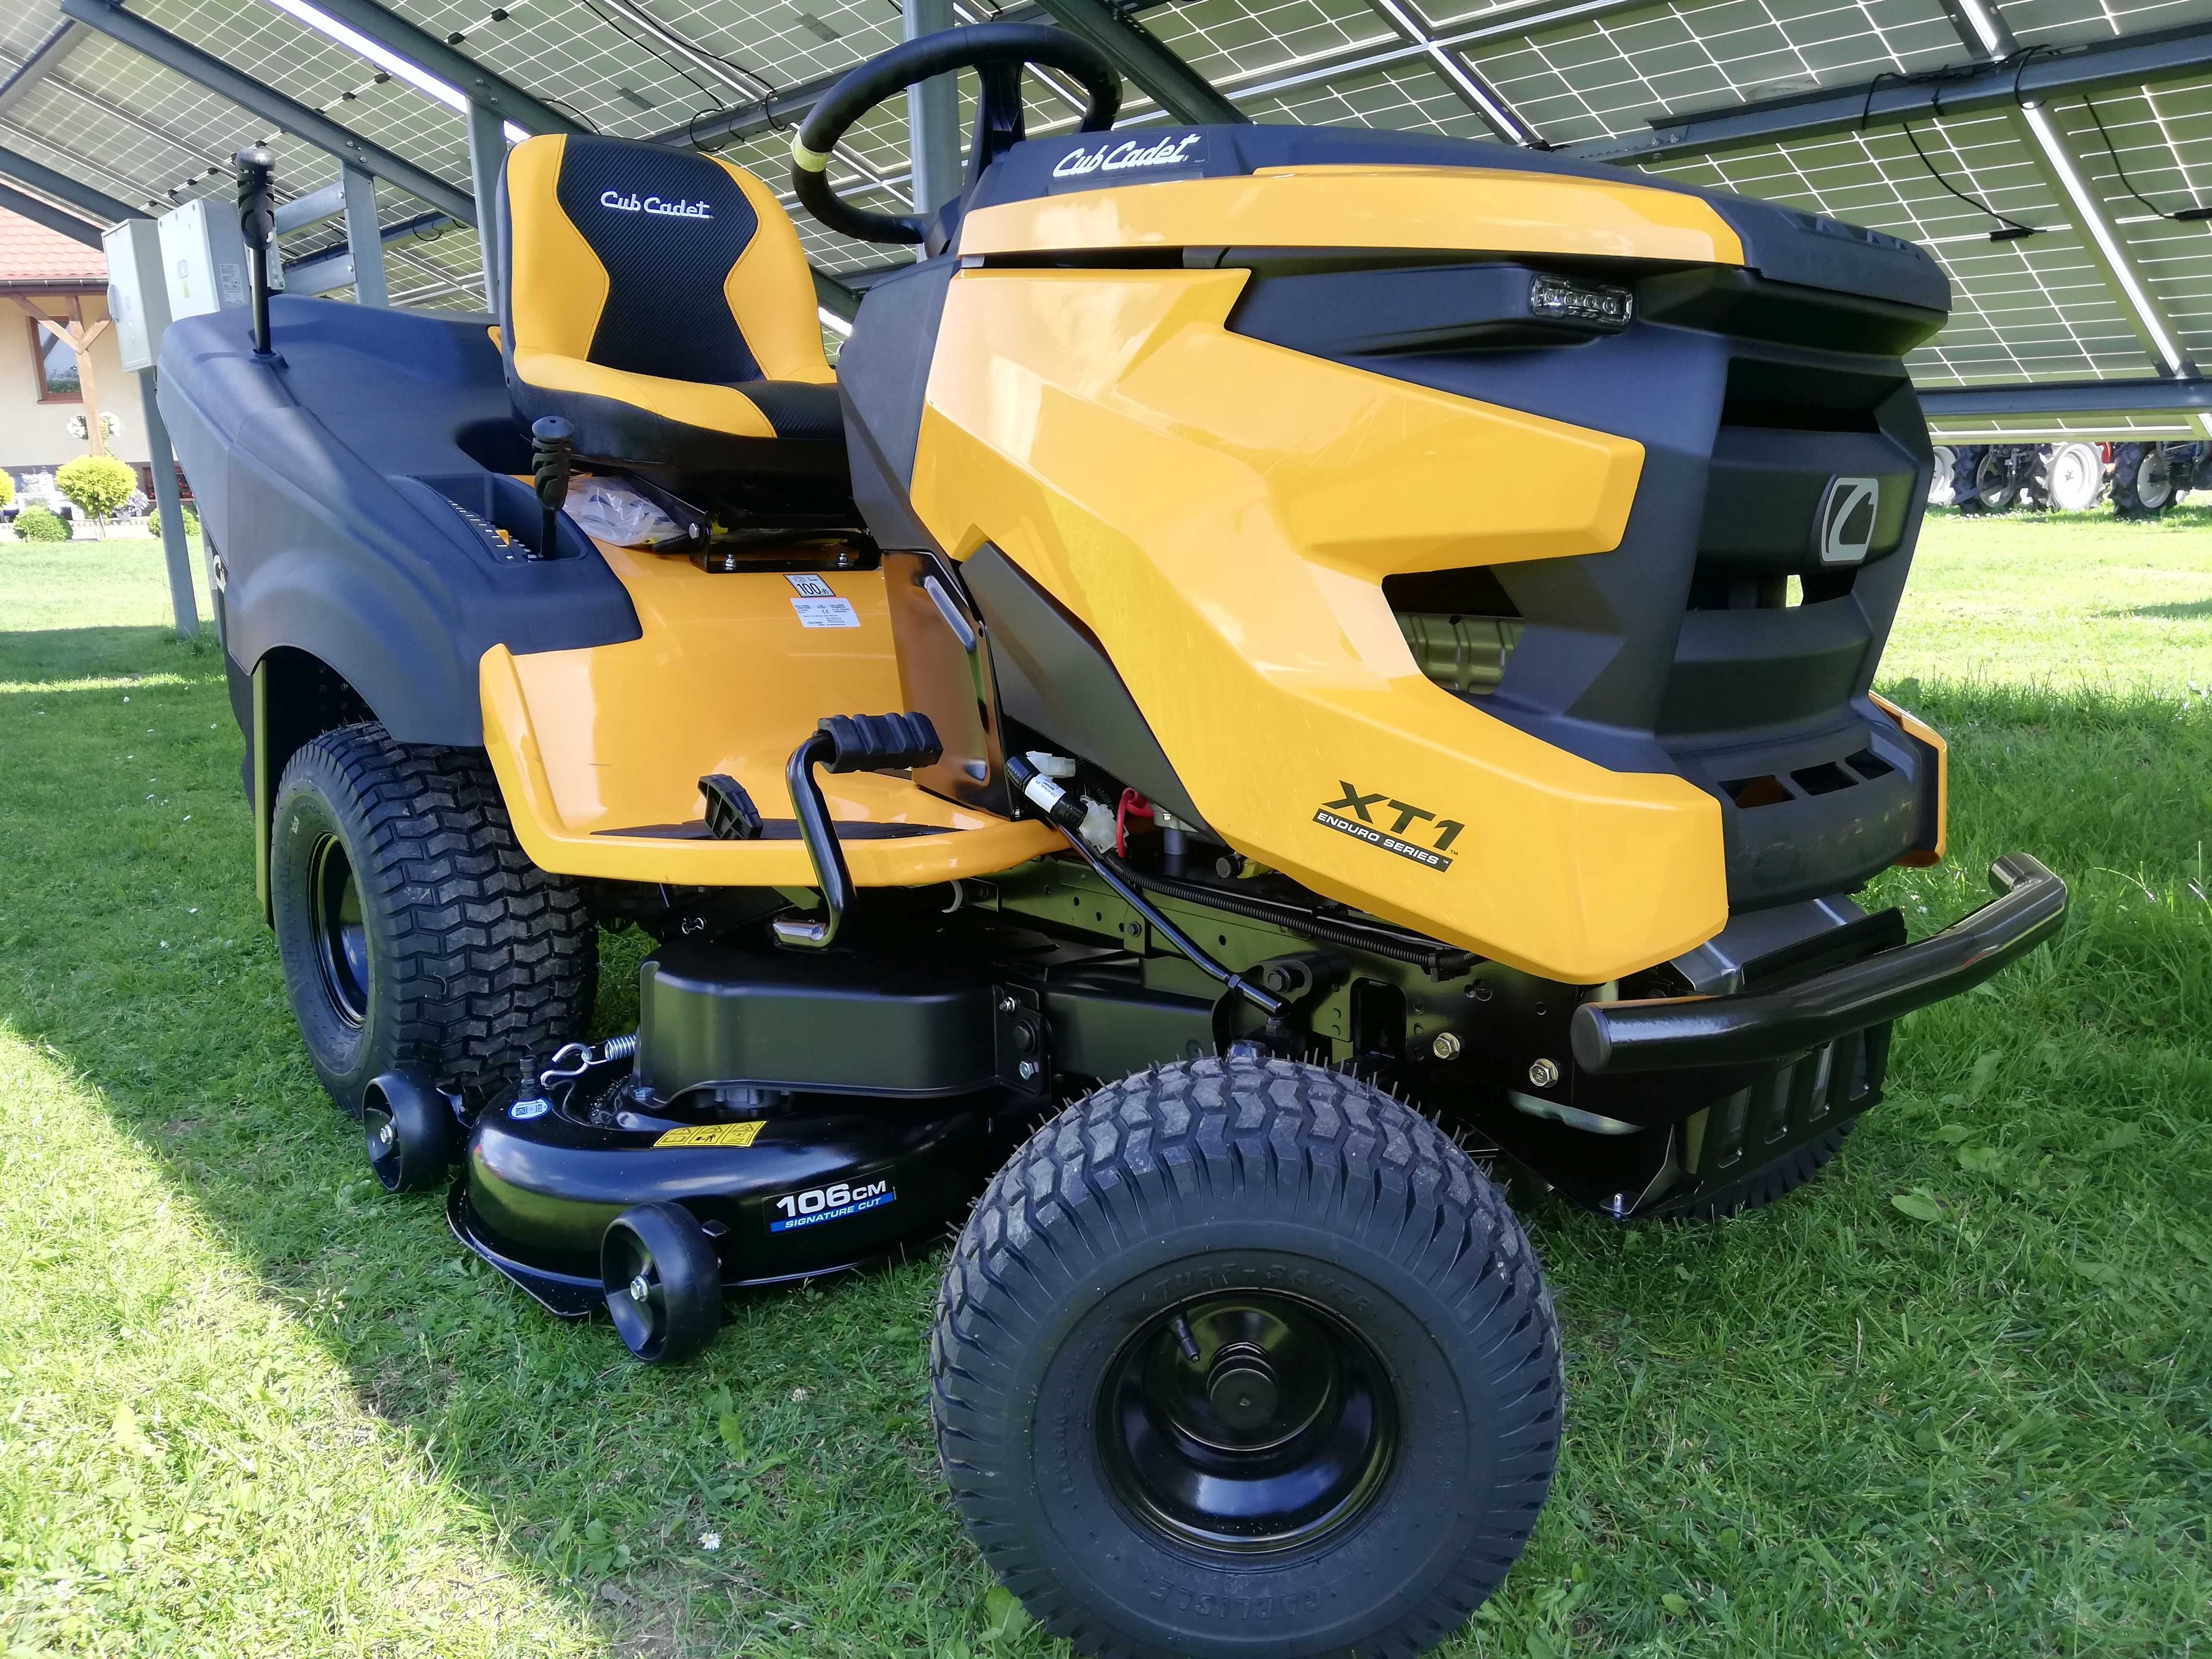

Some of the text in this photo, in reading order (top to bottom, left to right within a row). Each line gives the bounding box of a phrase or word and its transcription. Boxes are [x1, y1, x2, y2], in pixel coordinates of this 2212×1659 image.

[1053, 144, 1109, 177] Cub
[601, 191, 710, 218] Cub Cadet
[797, 583, 821, 594] 100
[1321, 779, 1466, 851] XT1
[1317, 812, 1380, 842] ENDURO
[1383, 838, 1439, 865] SERIES
[785, 1197, 881, 1228] SIGNATURE CUT
[1150, 1577, 1321, 1620] CARLISLE
